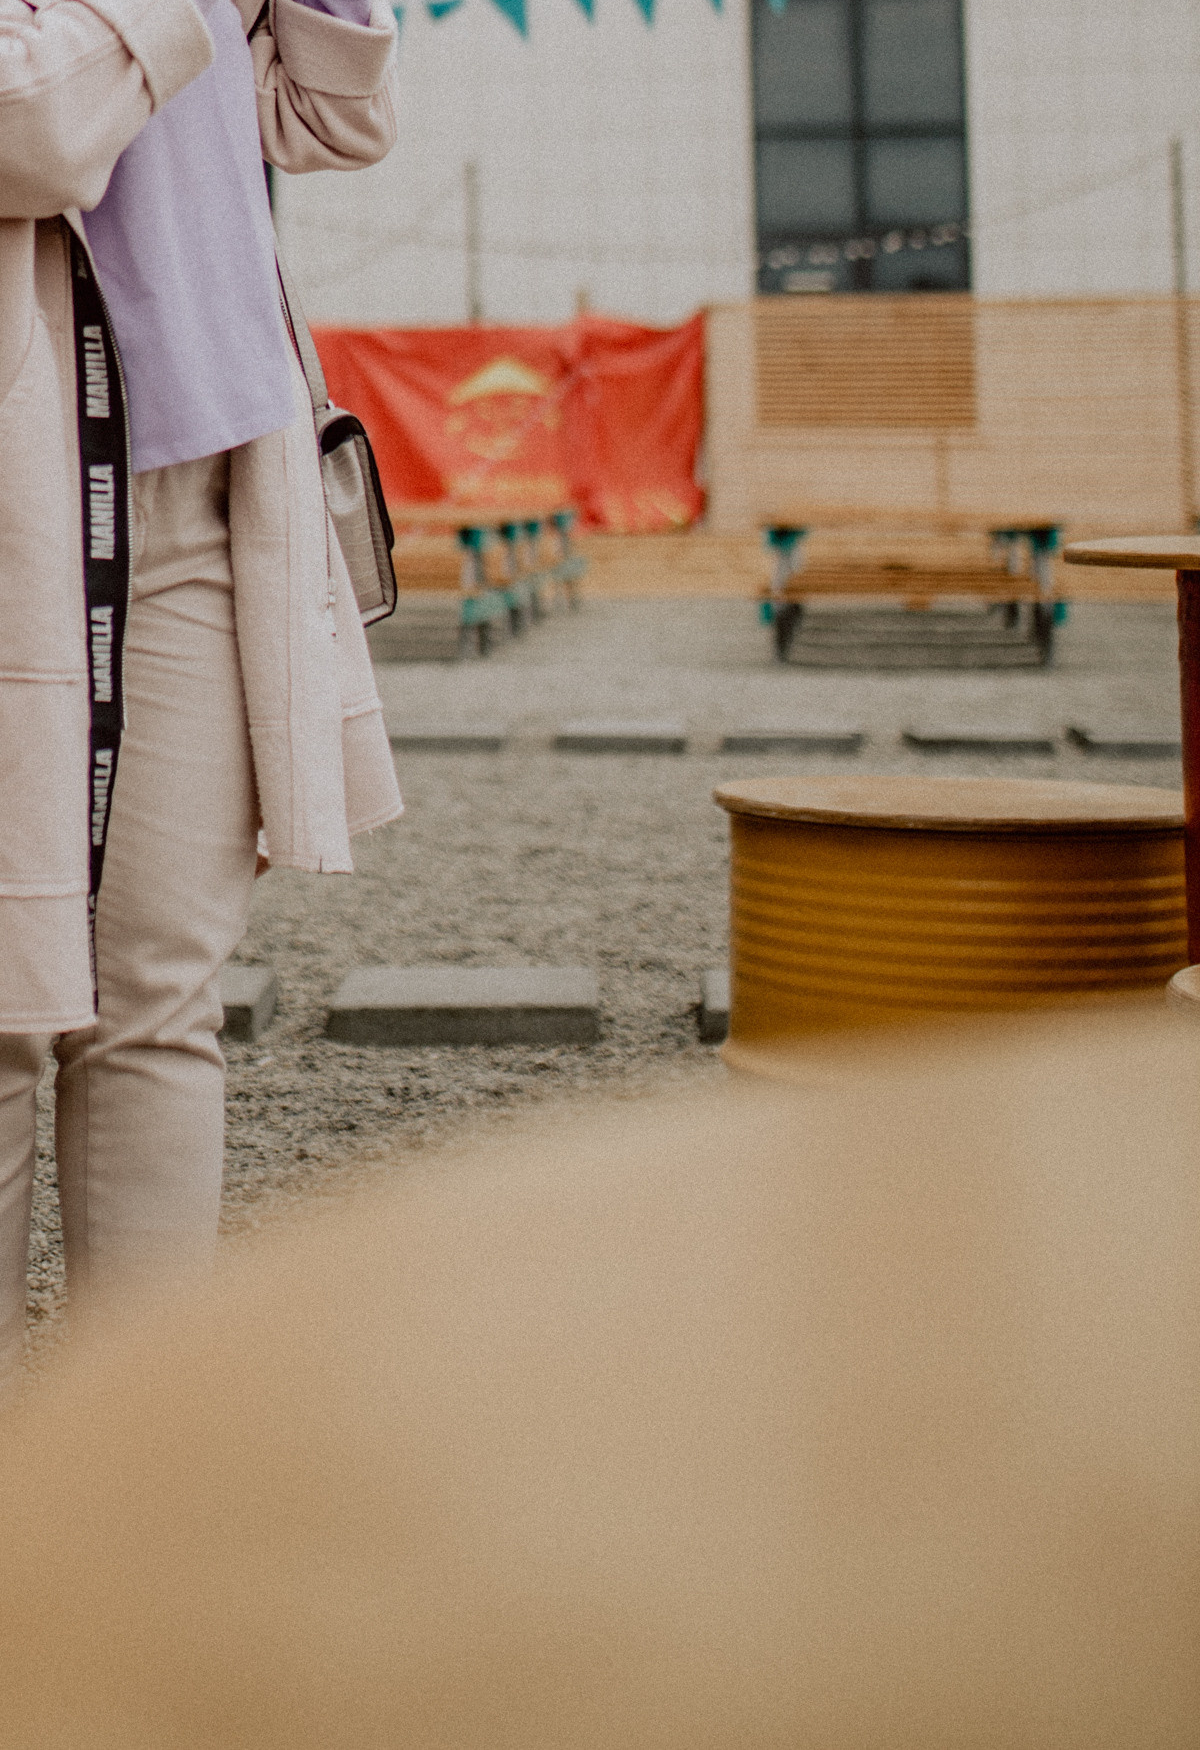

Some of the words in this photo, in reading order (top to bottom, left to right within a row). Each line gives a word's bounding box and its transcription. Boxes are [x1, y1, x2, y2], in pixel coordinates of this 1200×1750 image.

[83, 325, 110, 418] MANILLA
[89, 464, 115, 560] MANILLA
[90, 606, 113, 702] MANILLA
[92, 749, 113, 846] MANILLA
